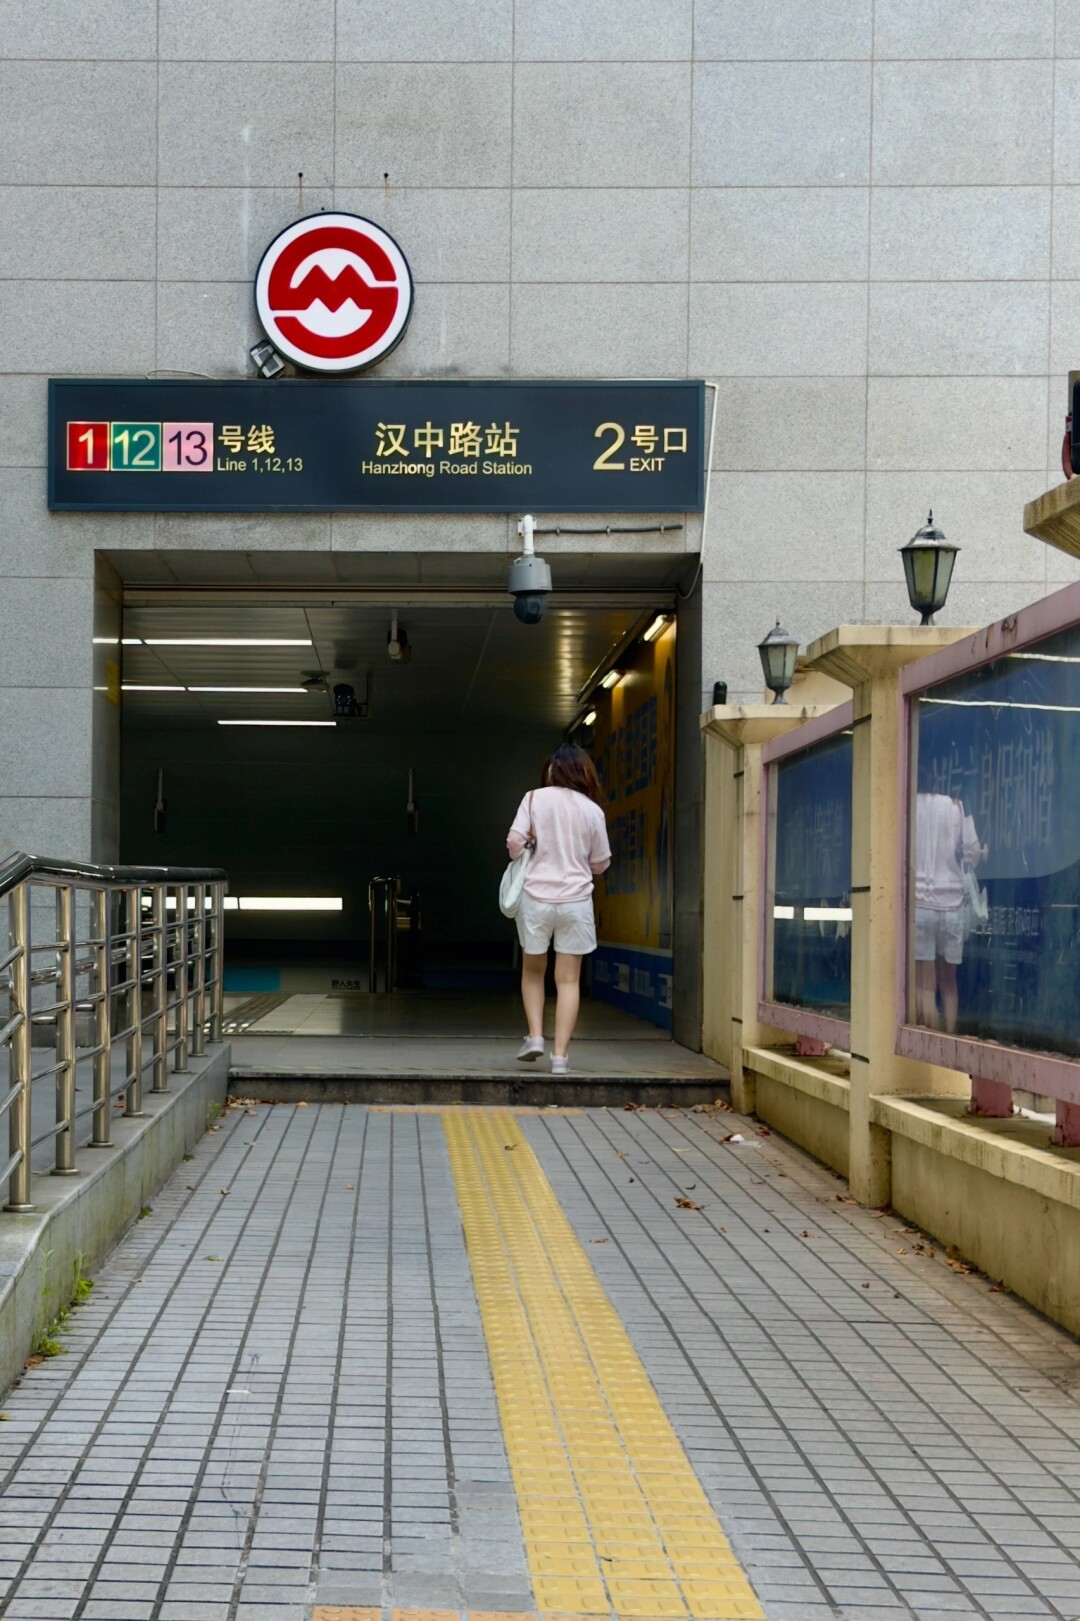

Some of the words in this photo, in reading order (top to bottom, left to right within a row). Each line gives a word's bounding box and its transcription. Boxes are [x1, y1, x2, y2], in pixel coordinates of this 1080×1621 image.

[78, 428, 94, 465] 1
[114, 429, 156, 466] 12
[168, 430, 208, 466] 13
[217, 424, 276, 454] 号线
[375, 421, 520, 458] 汉中路站
[217, 457, 247, 472] Line
[251, 457, 304, 473] 1,12,13
[361, 461, 435, 478] Hanzhong
[439, 461, 478, 475] Road
[482, 461, 533, 475] Station
[630, 458, 665, 471] EXIT
